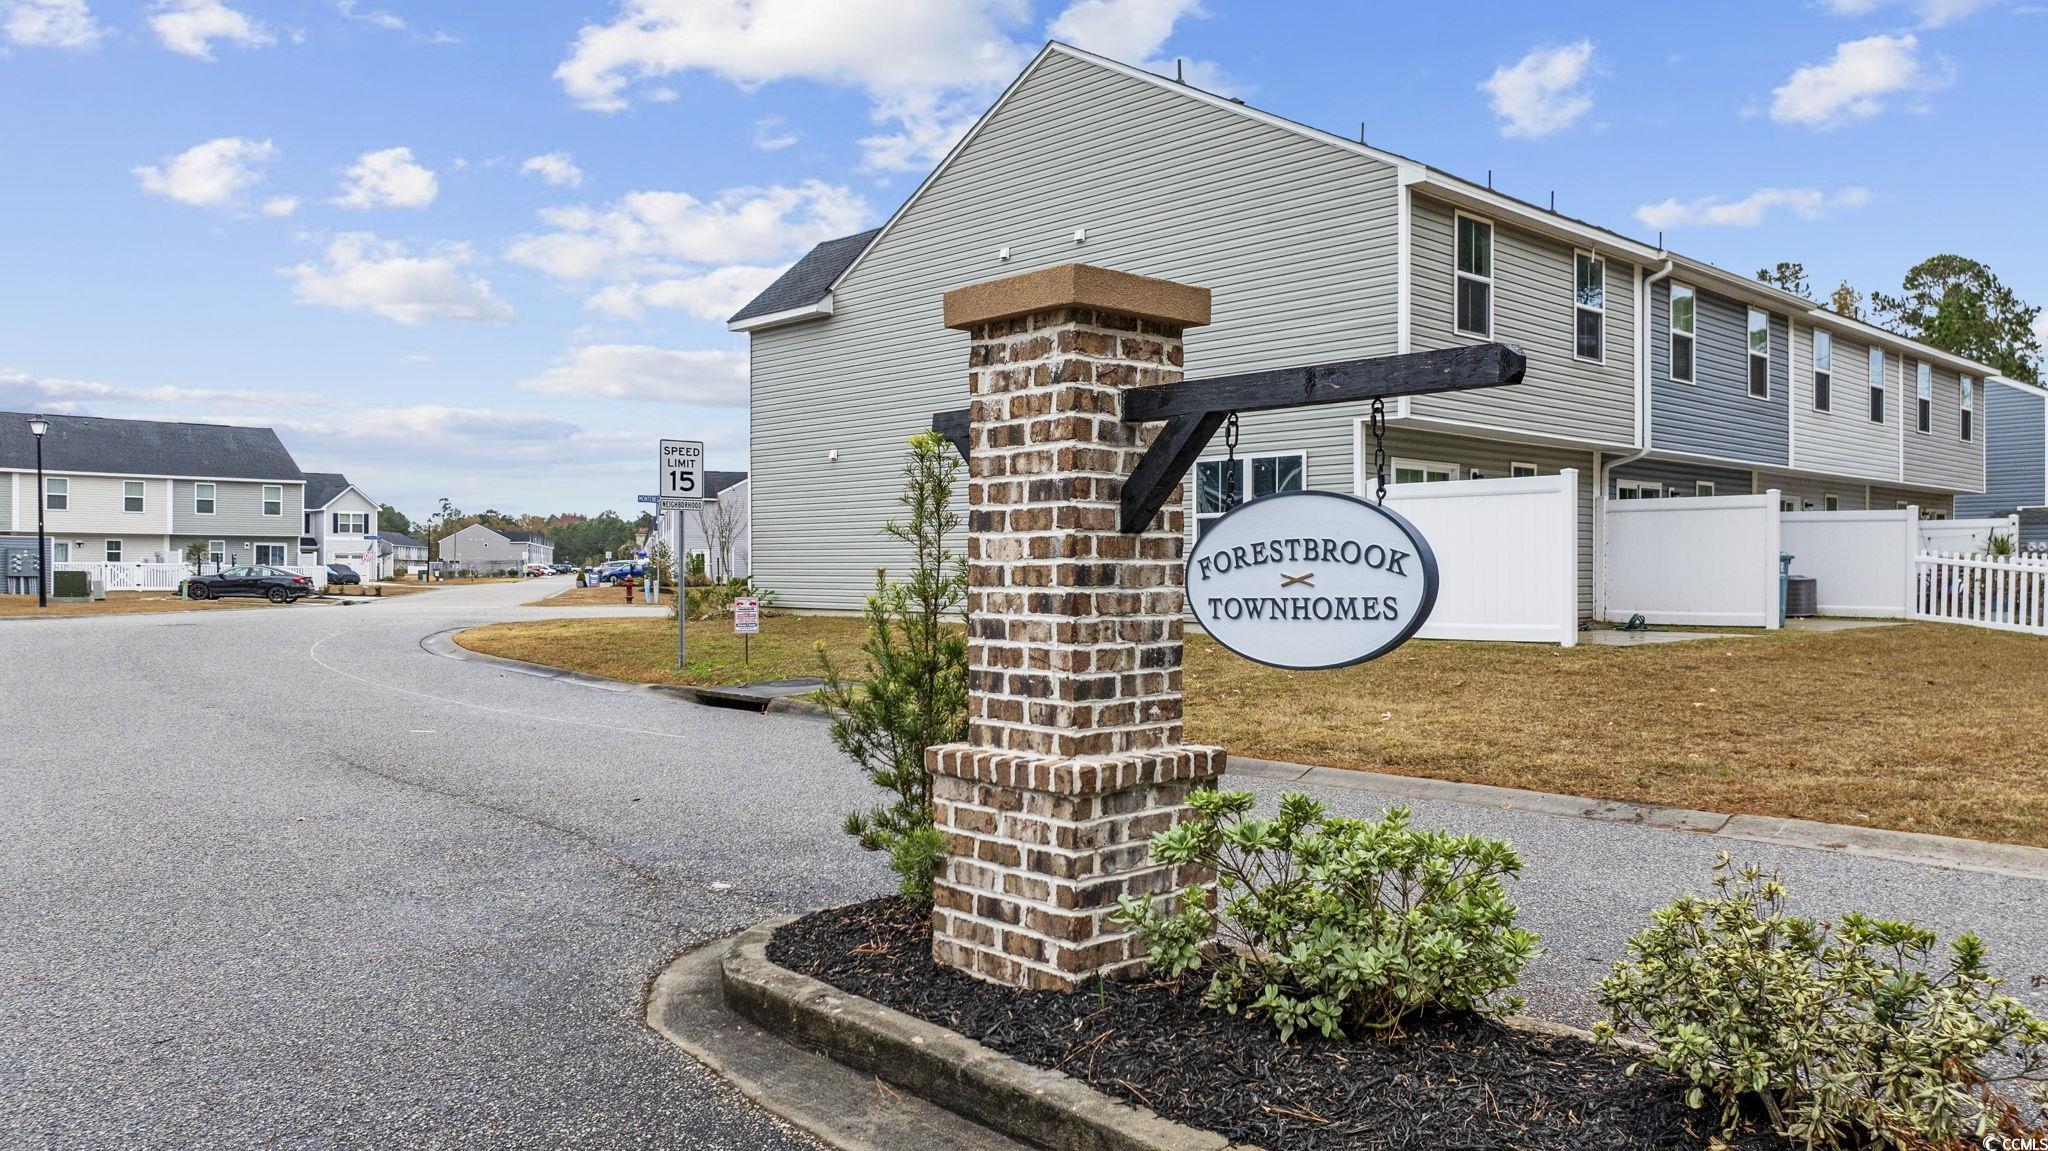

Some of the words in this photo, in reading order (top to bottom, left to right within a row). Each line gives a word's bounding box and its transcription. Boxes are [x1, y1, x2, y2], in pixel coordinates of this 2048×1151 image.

[664, 446, 700, 456] SPEED
[668, 458, 695, 468] LIMIT
[670, 470, 695, 491] 15
[662, 500, 702, 509] NEIGHBORHOOD
[1197, 538, 1411, 580] FORESTBROOK
[1208, 596, 1399, 621] TOWNHOMES
